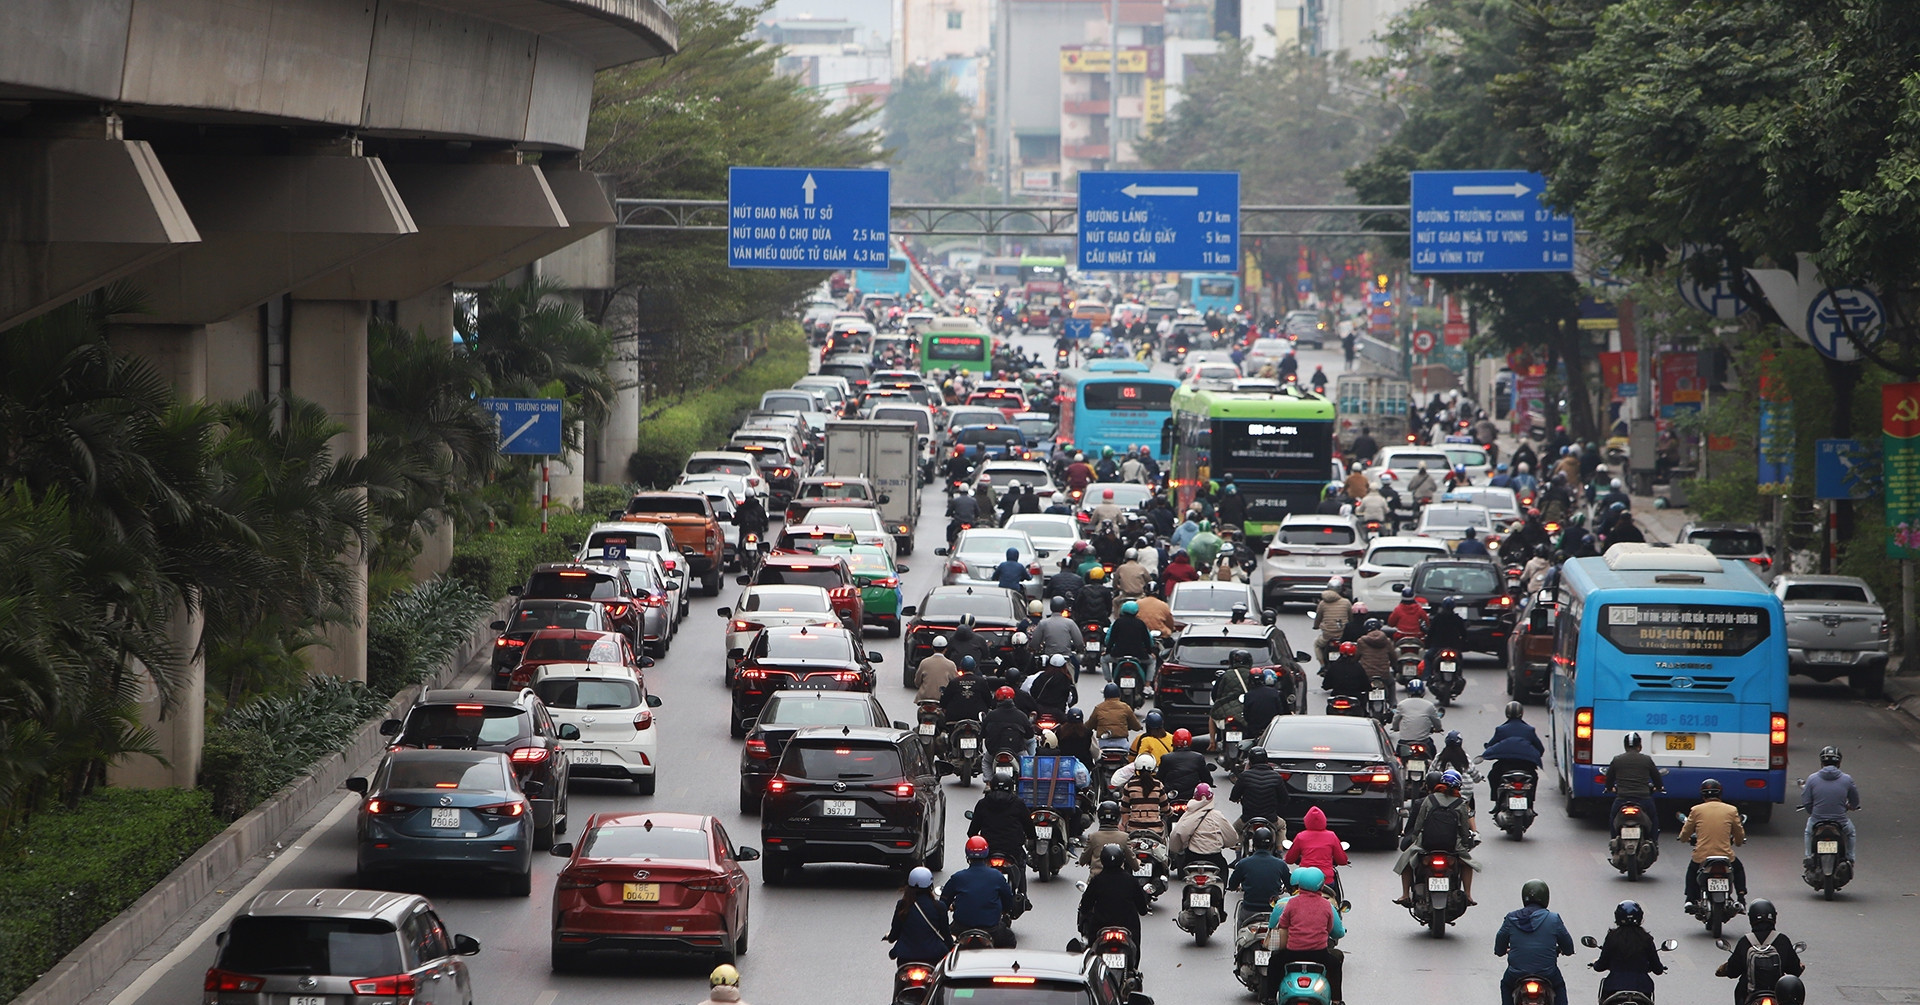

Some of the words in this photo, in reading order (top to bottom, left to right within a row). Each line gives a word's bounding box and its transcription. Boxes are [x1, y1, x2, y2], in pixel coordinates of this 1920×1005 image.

[733, 204, 751, 219] NÚT
[755, 207, 776, 219] GIAO
[780, 205, 799, 220] NGÃ
[820, 204, 833, 220] SỞ
[1086, 207, 1119, 223] ĐƯỜNG
[1122, 207, 1148, 223] LÁNG
[1215, 211, 1231, 223] km
[1495, 210, 1525, 222] CHINH
[733, 224, 751, 239] NÚT
[755, 227, 776, 239] GIAO
[780, 225, 786, 239] Ô
[789, 228, 808, 242] CHỢ
[870, 229, 885, 241] km
[1086, 227, 1105, 243] NÚT
[1108, 231, 1130, 243] GIAO
[1206, 232, 1212, 243] 5
[1215, 231, 1231, 243] km
[1417, 228, 1436, 243] NÚT
[1439, 231, 1460, 243] GIAO
[1543, 231, 1549, 242] 3
[1552, 230, 1568, 242] km
[734, 246, 751, 259] VĂN
[755, 244, 777, 260] MIẾU
[780, 244, 804, 260] QUỐC
[823, 246, 847, 261] GIÁM
[870, 249, 884, 261] km
[1108, 249, 1133, 264] NHẬT
[1202, 252, 1212, 264] 11
[1215, 252, 1231, 263] km
[1466, 251, 1484, 263] TUY
[1543, 251, 1549, 262] 8
[1552, 251, 1568, 262] km
[1123, 387, 1136, 398] 01
[541, 403, 559, 412] CHINH
[1646, 713, 1668, 725] 29B
[1679, 714, 1719, 727] 621.80
[1313, 775, 1327, 783] 30A
[833, 800, 846, 808] 30K
[438, 809, 453, 817] 30A
[627, 892, 655, 900] 004.77
